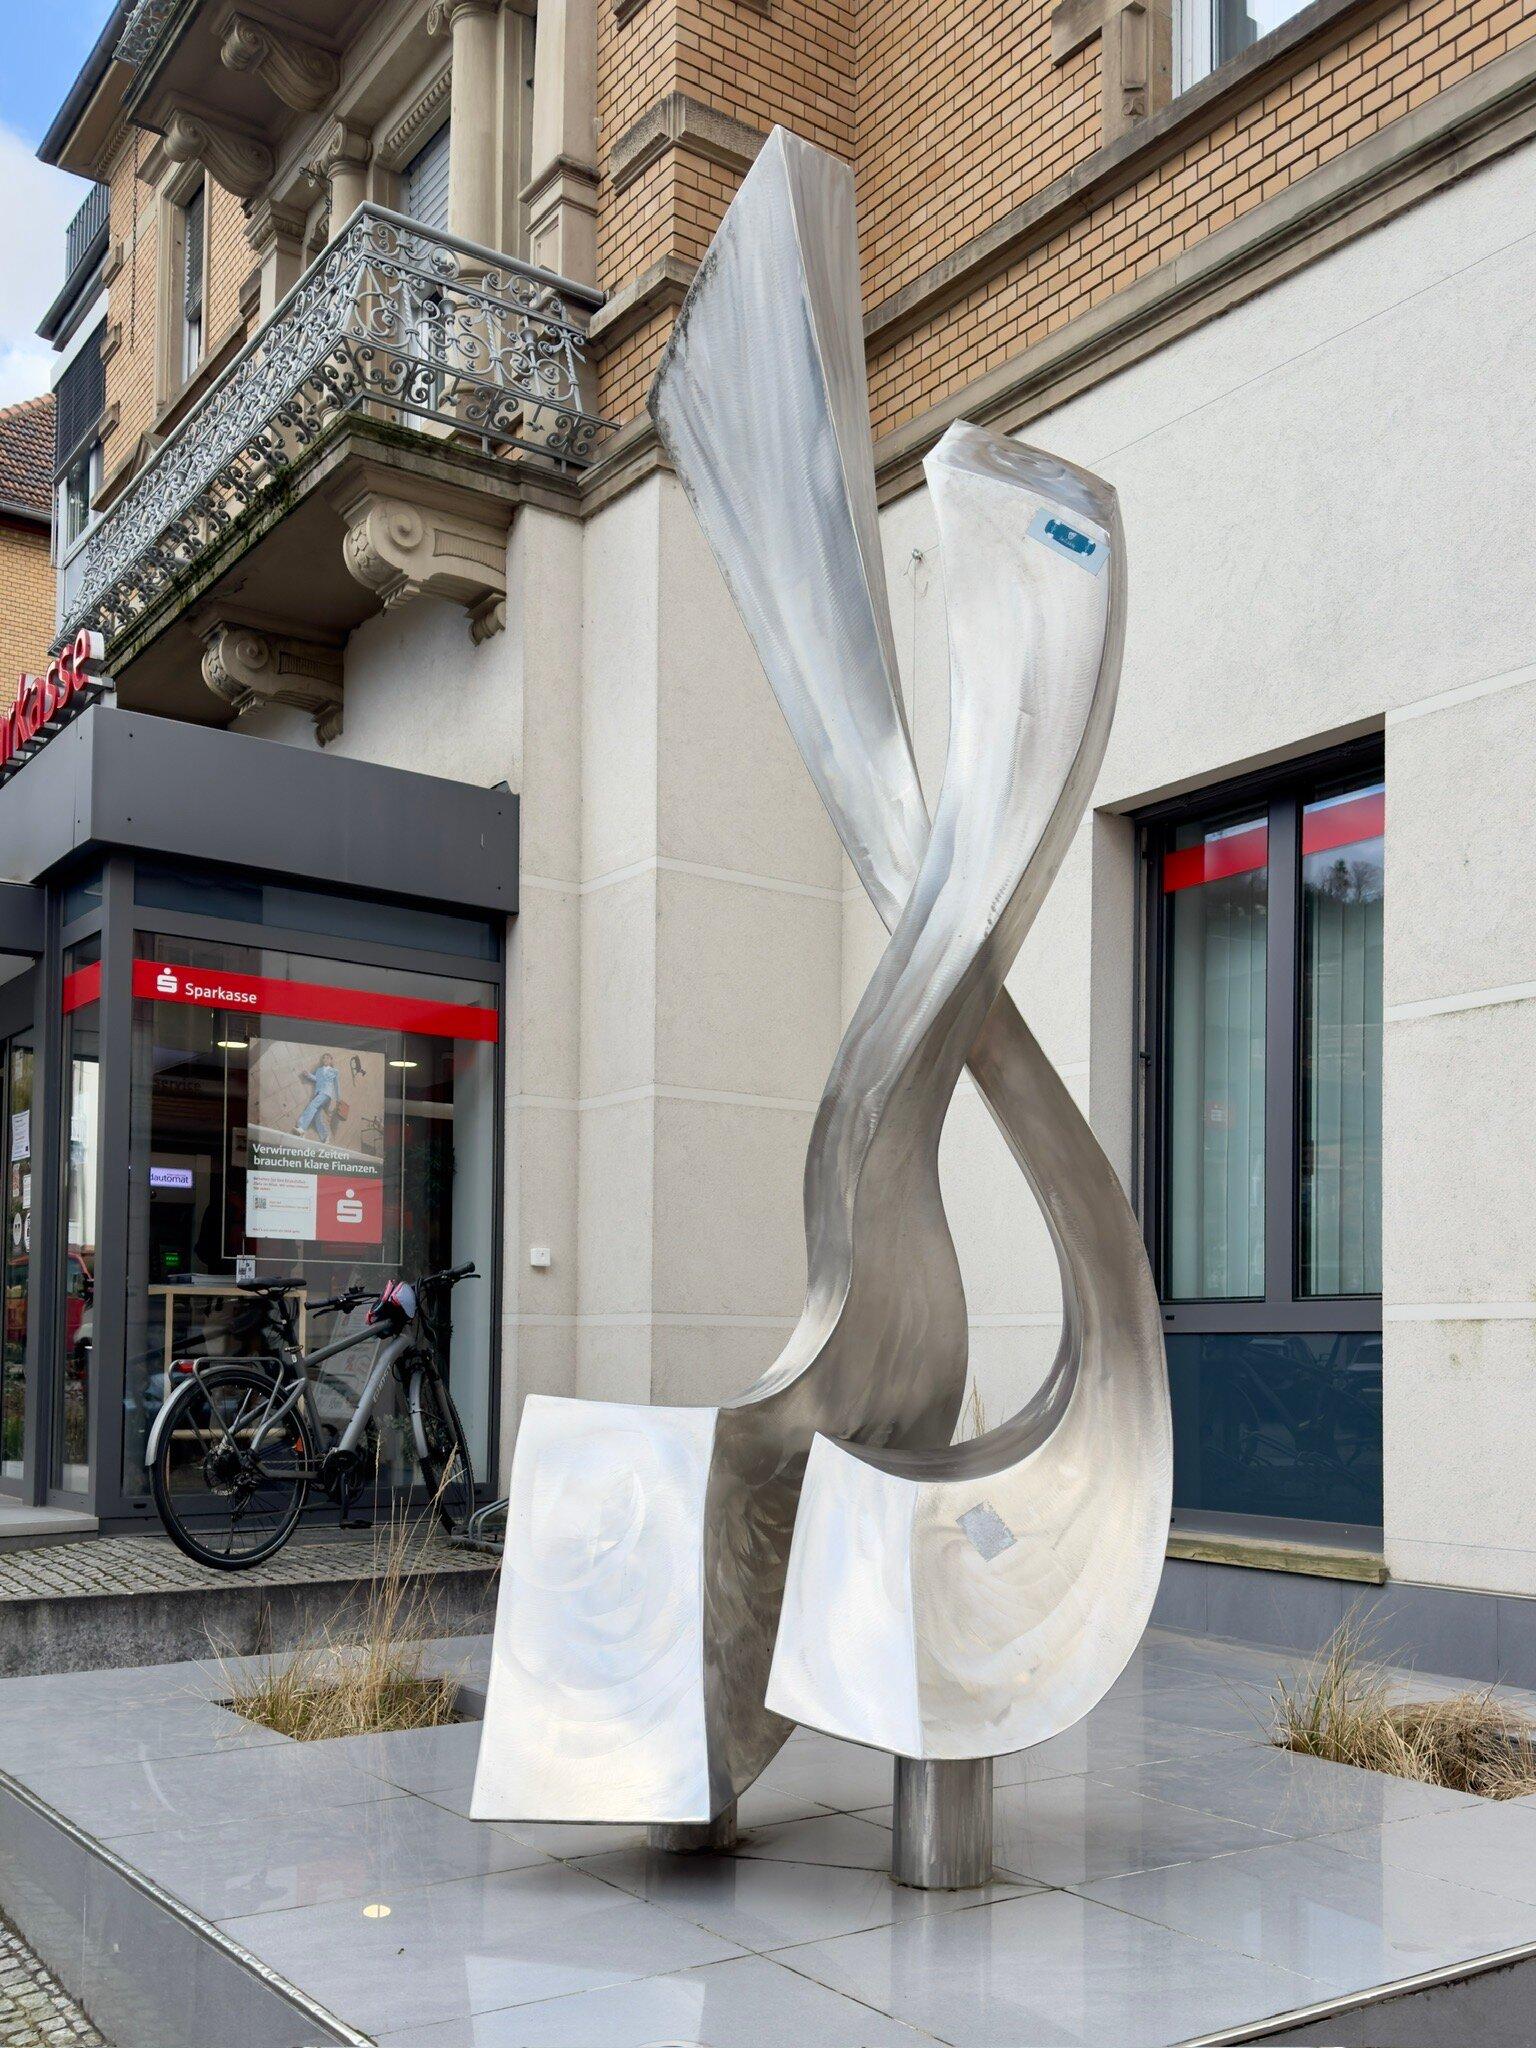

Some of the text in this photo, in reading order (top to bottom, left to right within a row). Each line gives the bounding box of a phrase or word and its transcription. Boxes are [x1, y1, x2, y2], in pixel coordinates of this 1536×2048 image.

[185, 982, 257, 1004] Sparkasse
[252, 1143, 350, 1160] Verwirrende Zeiten
[253, 1155, 378, 1174] brauchen klare Finanzen.
